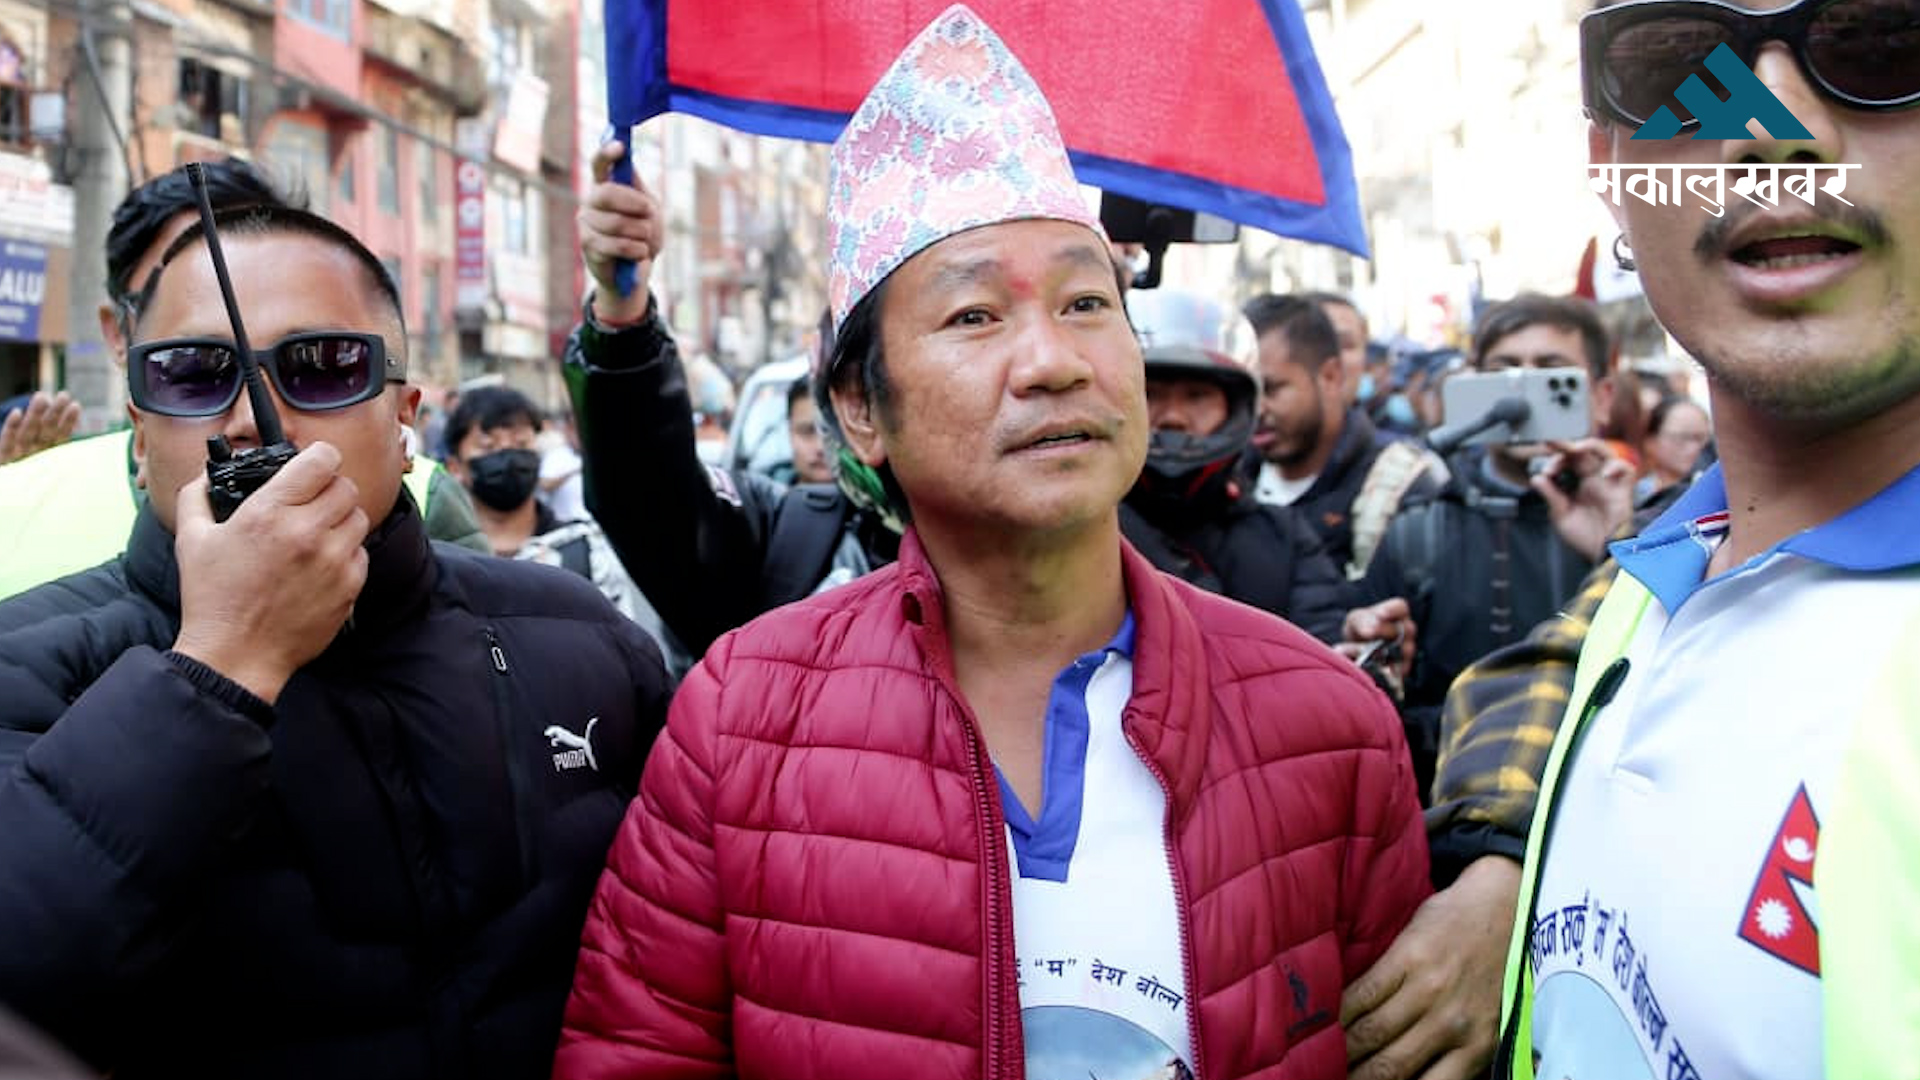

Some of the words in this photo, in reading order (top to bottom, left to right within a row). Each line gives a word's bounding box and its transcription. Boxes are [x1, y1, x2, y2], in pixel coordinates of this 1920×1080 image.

[553, 748, 587, 772] PUMA
[1091, 958, 1127, 987] देश
[1136, 975, 1183, 1012] बोल्न
